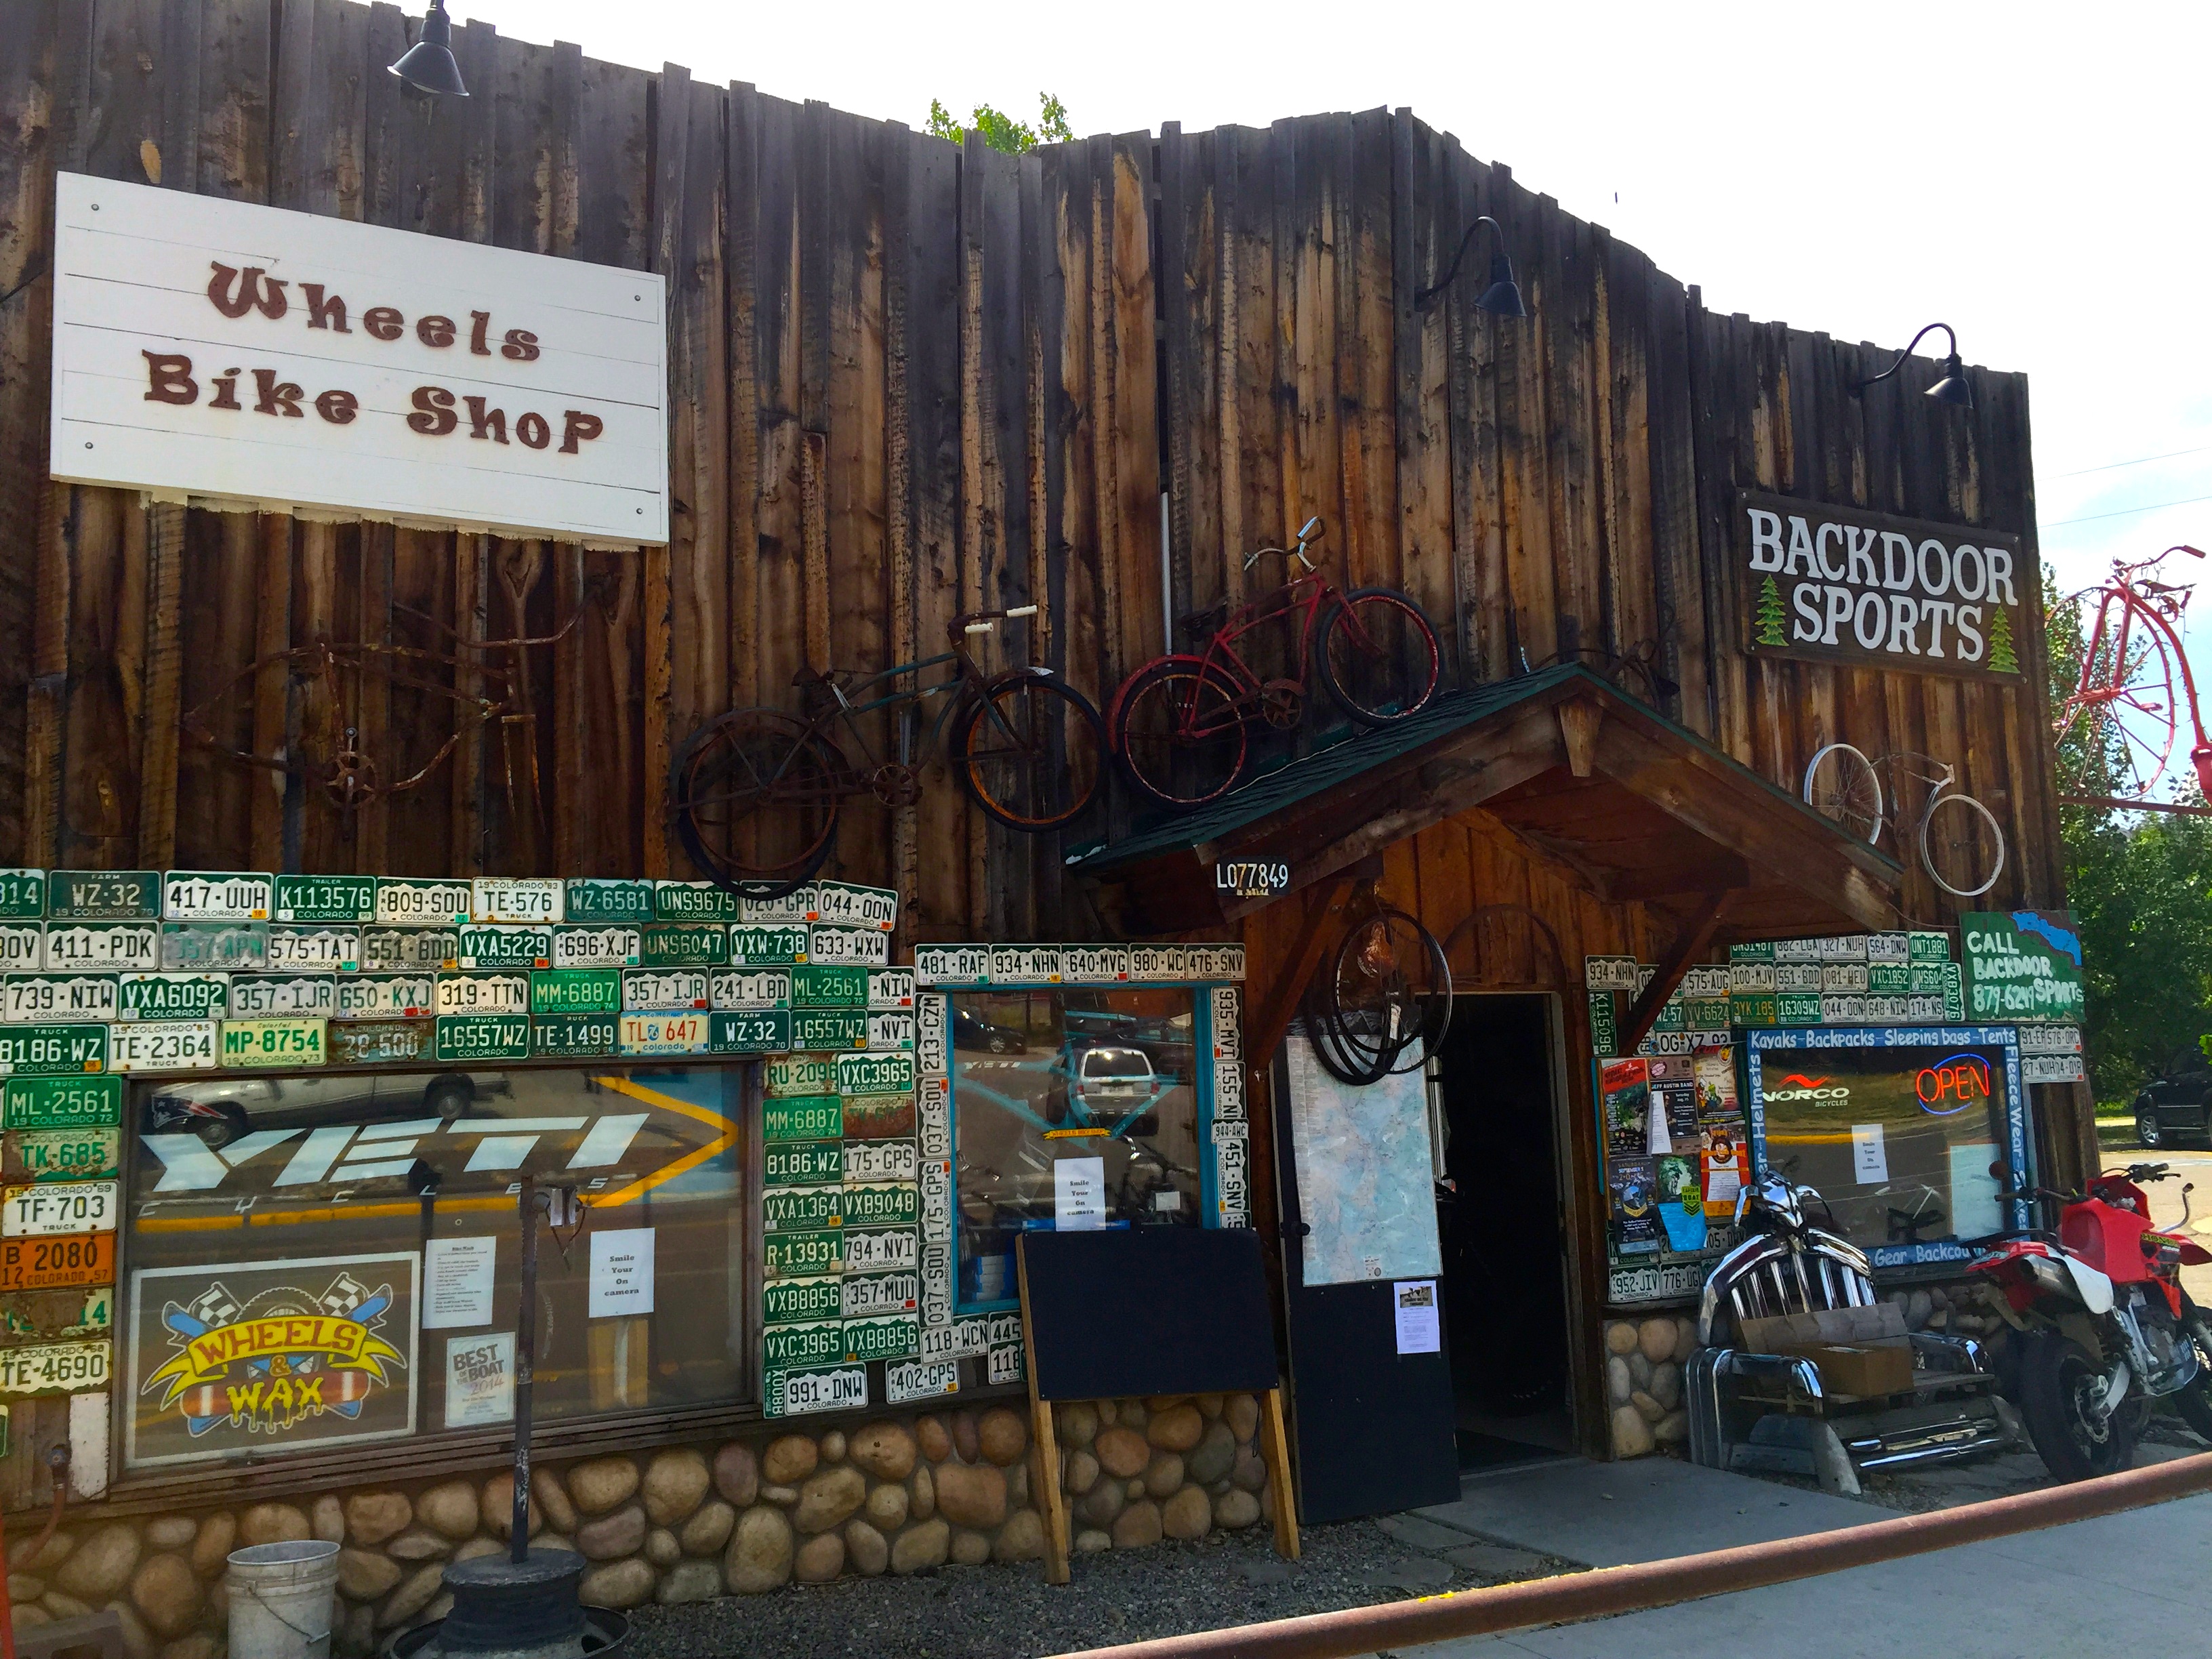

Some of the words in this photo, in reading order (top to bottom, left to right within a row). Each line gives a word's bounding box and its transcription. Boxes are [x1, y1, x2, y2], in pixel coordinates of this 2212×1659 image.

[208, 260, 541, 361] Wheels
[407, 386, 603, 455] Shop
[1746, 508, 2018, 606] BACKDOOR
[1793, 582, 1983, 661] SPORTS
[280, 887, 371, 908] K113576
[661, 890, 735, 911] UNS9675
[297, 910, 353, 918] COLORADO
[836, 915, 874, 926] COLORADO
[465, 935, 548, 958] VXA5229
[1967, 930, 2020, 954] CALL
[1973, 956, 2053, 980] BACKDOOR
[125, 984, 222, 1008] VXA6092
[2034, 978, 2083, 1004] SPORTS
[131, 1025, 192, 1033] COLORADO
[441, 1025, 525, 1048] 16557WZ
[666, 1021, 697, 1041] 647
[795, 1019, 864, 1040] 16557WZ
[1978, 1028, 2015, 1044] Tents
[18, 1063, 80, 1071] COLORADO
[842, 1063, 909, 1084] VXC3965
[1763, 1088, 1849, 1101] NORCO
[1916, 1065, 1989, 1101] OPEN
[1750, 1054, 1765, 1138] Helmets
[140, 1113, 650, 1191] YETI
[766, 1196, 838, 1219] VXA1364
[845, 1193, 914, 1214] VXB9048
[35, 1242, 97, 1271] 2080
[781, 1263, 825, 1272] COLORADO
[768, 1289, 838, 1312] VXB8856
[198, 1319, 359, 1366] WHEELS
[767, 1332, 839, 1357] VXC3965
[848, 1326, 916, 1348] VXB8856
[270, 1355, 291, 1376] &
[453, 1344, 497, 1372] BEST
[468, 1360, 504, 1382] BOAT
[226, 1377, 324, 1423] WAX
[808, 1399, 846, 1408] COLORADO
